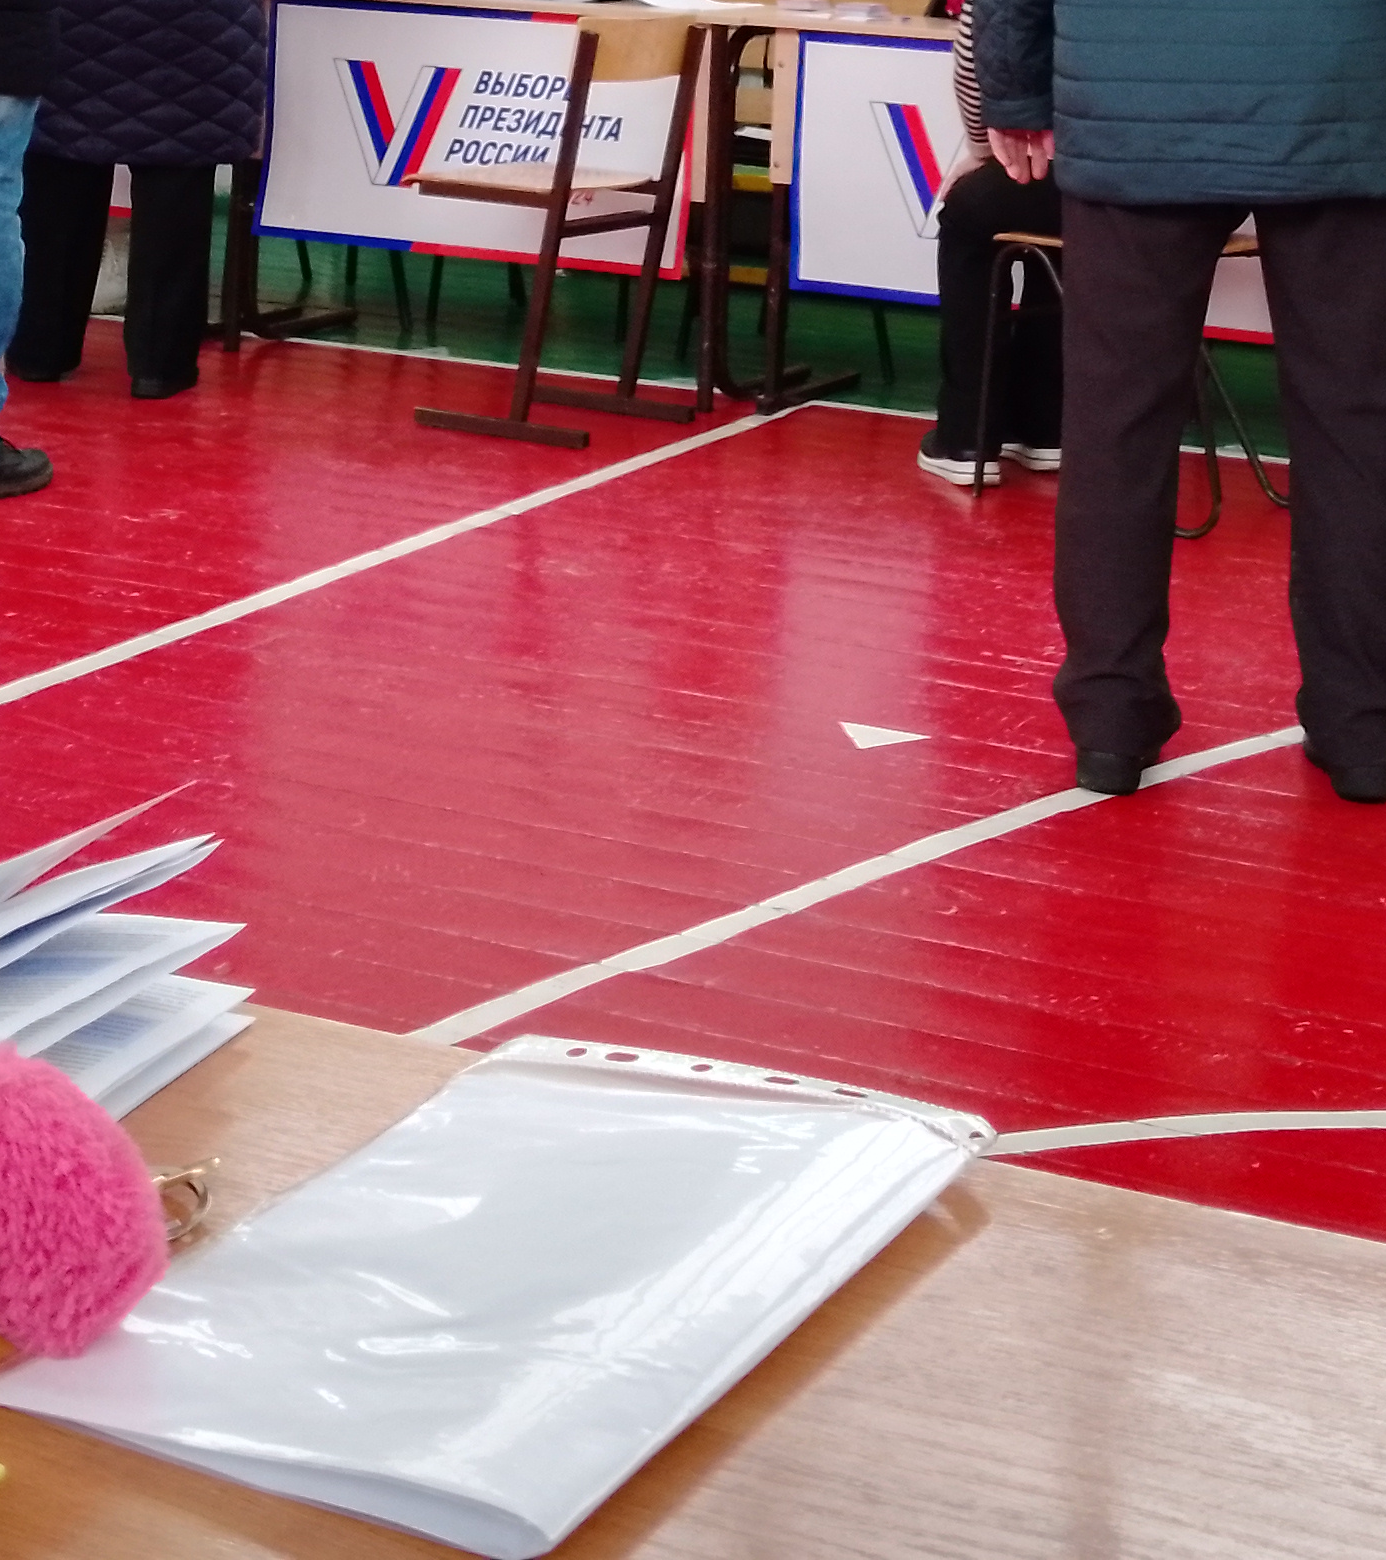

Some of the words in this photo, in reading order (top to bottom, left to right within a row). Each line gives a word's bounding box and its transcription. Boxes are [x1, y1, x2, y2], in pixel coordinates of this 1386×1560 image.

[473, 70, 572, 102] ВЫБОР
[459, 104, 624, 142] ПРЕЗИДНТА
[444, 139, 550, 166] РОССИИ
